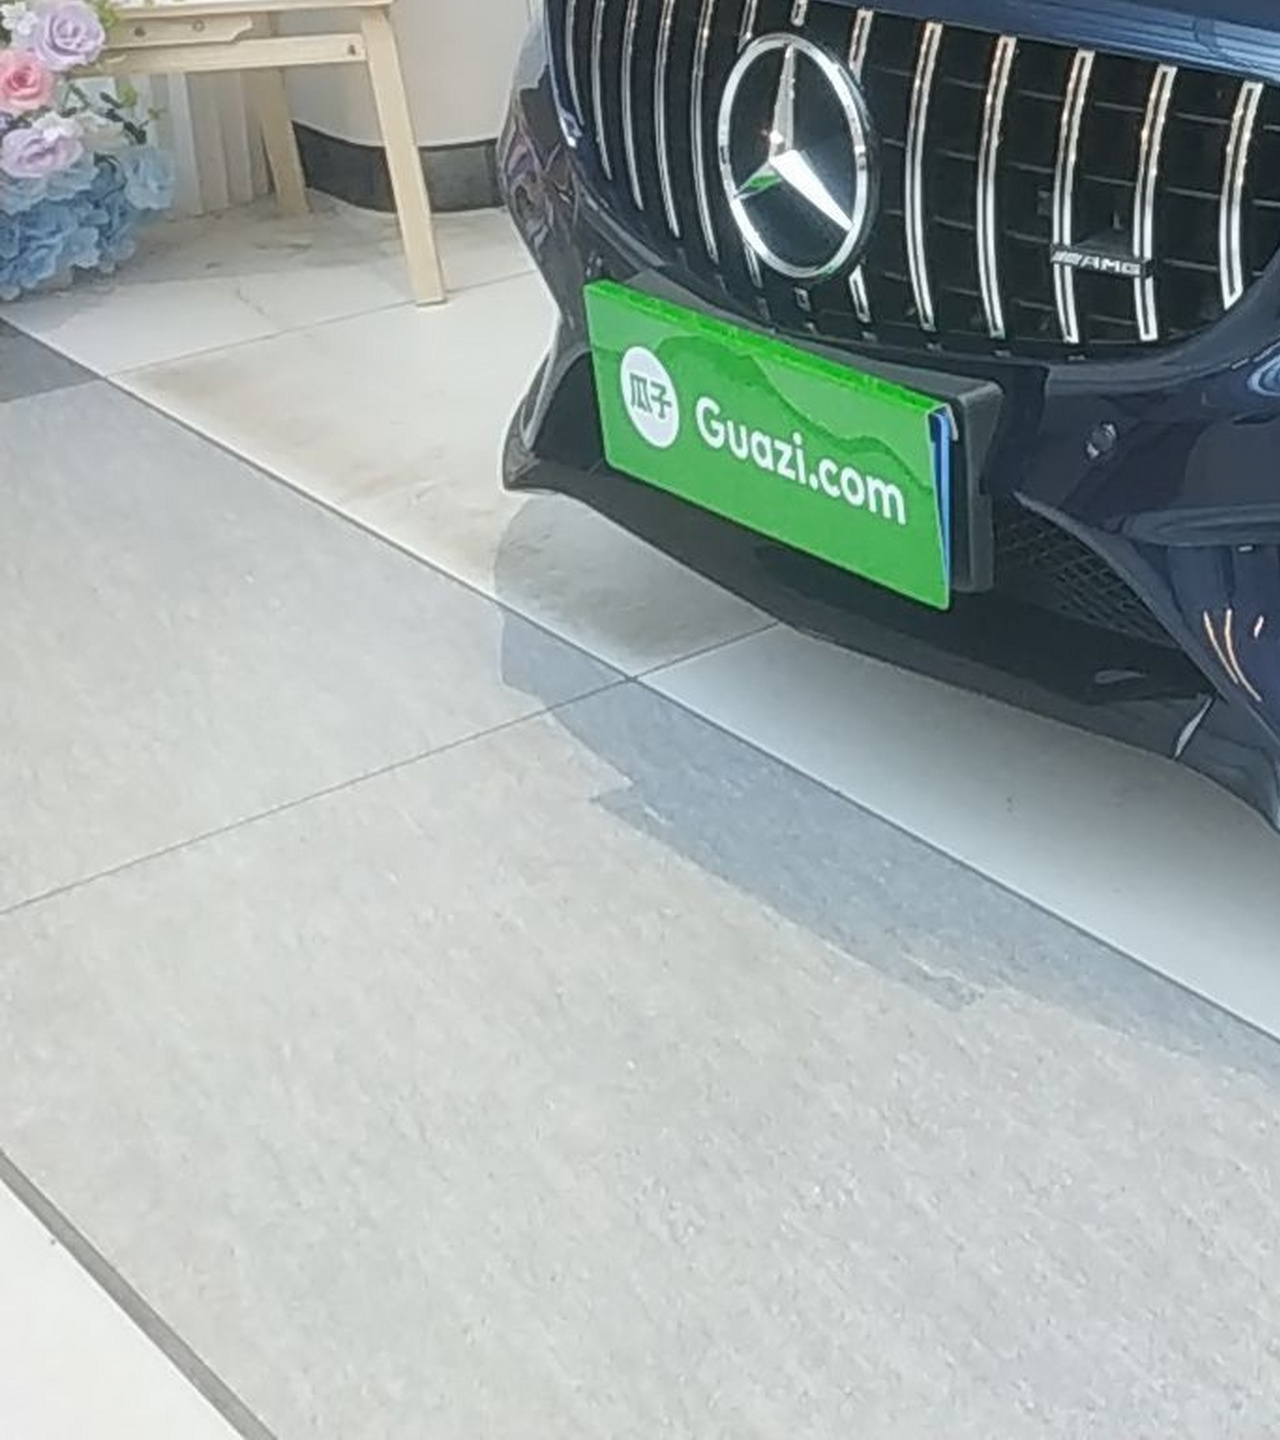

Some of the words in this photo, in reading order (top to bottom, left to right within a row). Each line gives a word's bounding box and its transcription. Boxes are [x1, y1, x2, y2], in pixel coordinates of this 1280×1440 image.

[1080, 255, 1141, 276] AMG
[629, 371, 673, 420] 瓜子
[695, 396, 907, 525] Guazi.com
